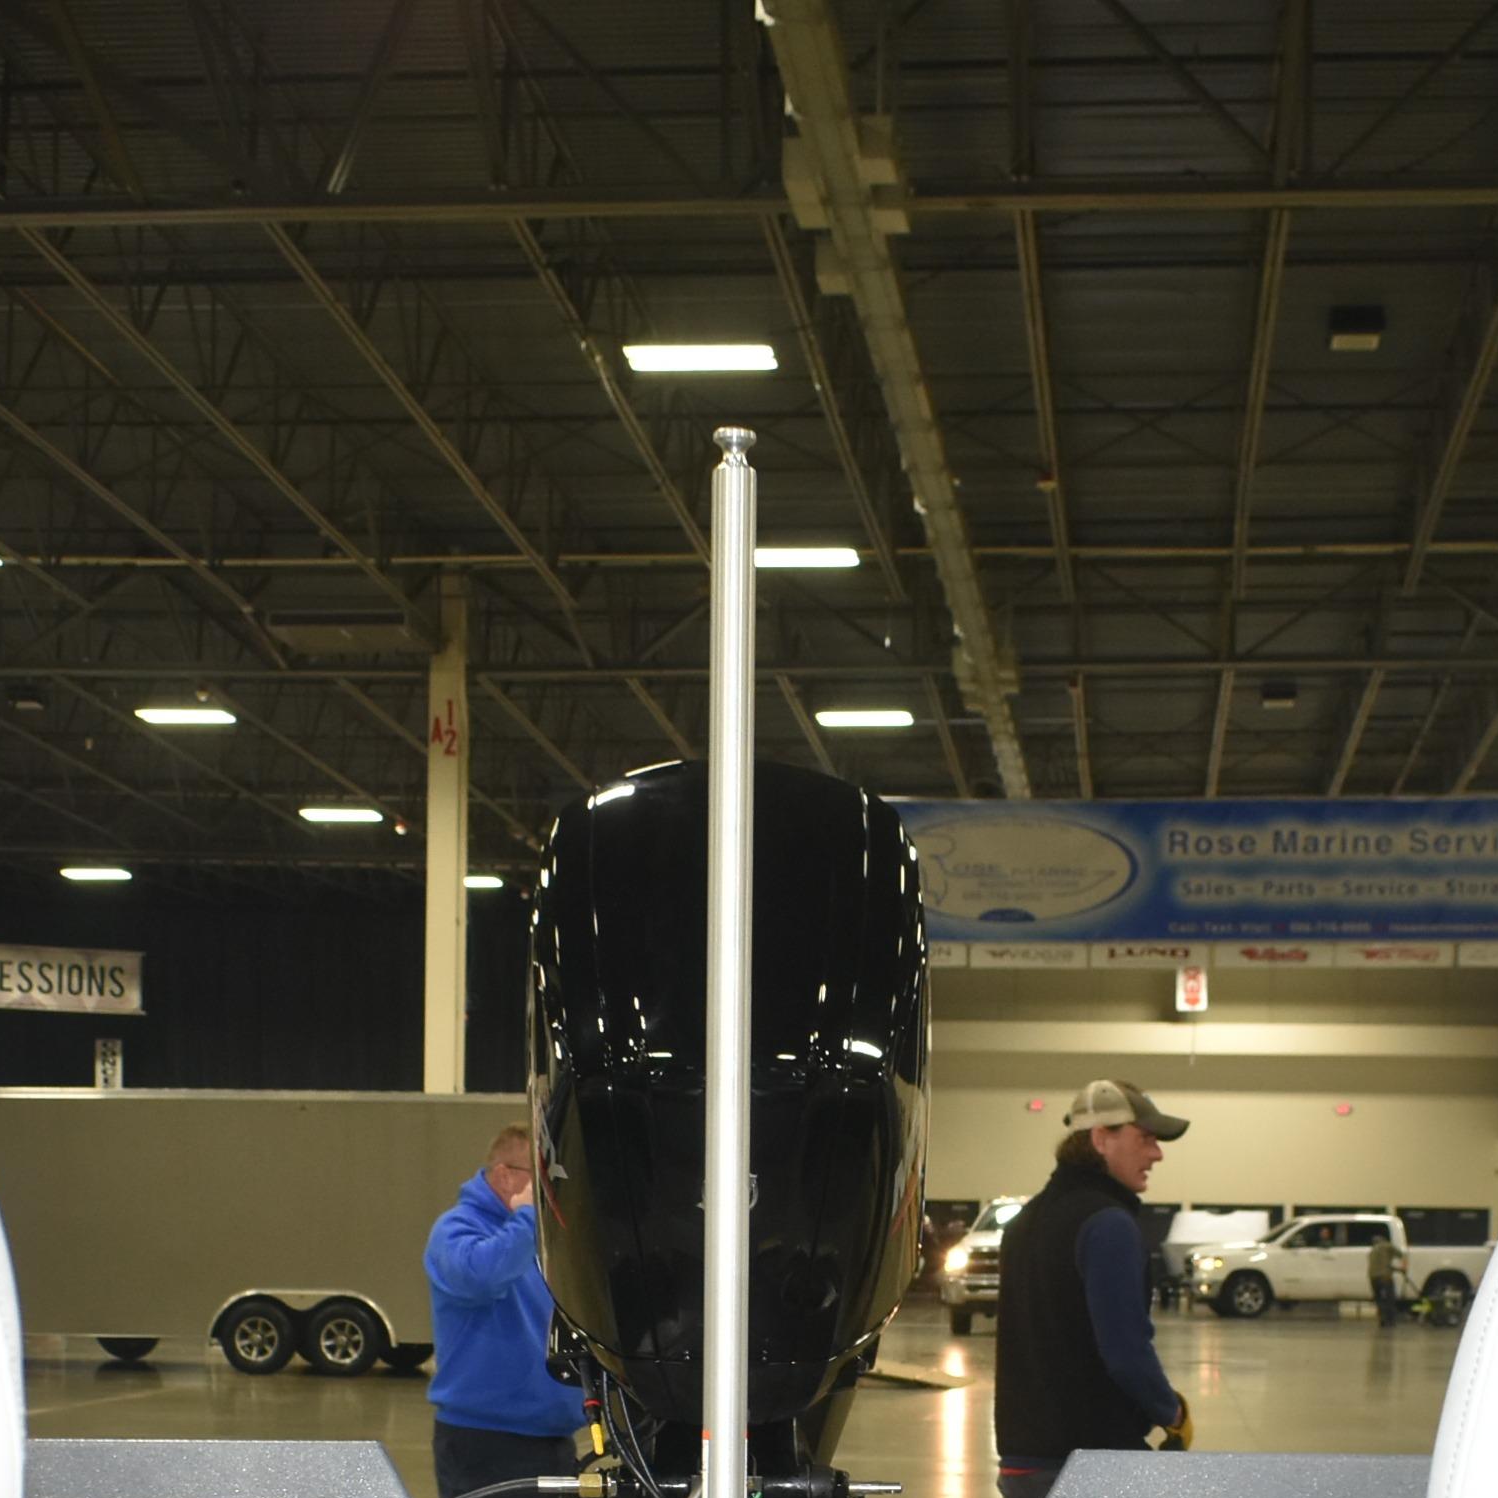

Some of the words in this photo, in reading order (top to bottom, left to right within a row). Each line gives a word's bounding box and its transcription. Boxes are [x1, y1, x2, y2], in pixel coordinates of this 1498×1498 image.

[1167, 829, 1258, 855] Rose
[1272, 829, 1394, 856] Marine
[1180, 879, 1237, 897] Sales
[1262, 879, 1317, 897] Parts
[1340, 879, 1420, 897] Service
[1107, 946, 1191, 960] LUND
